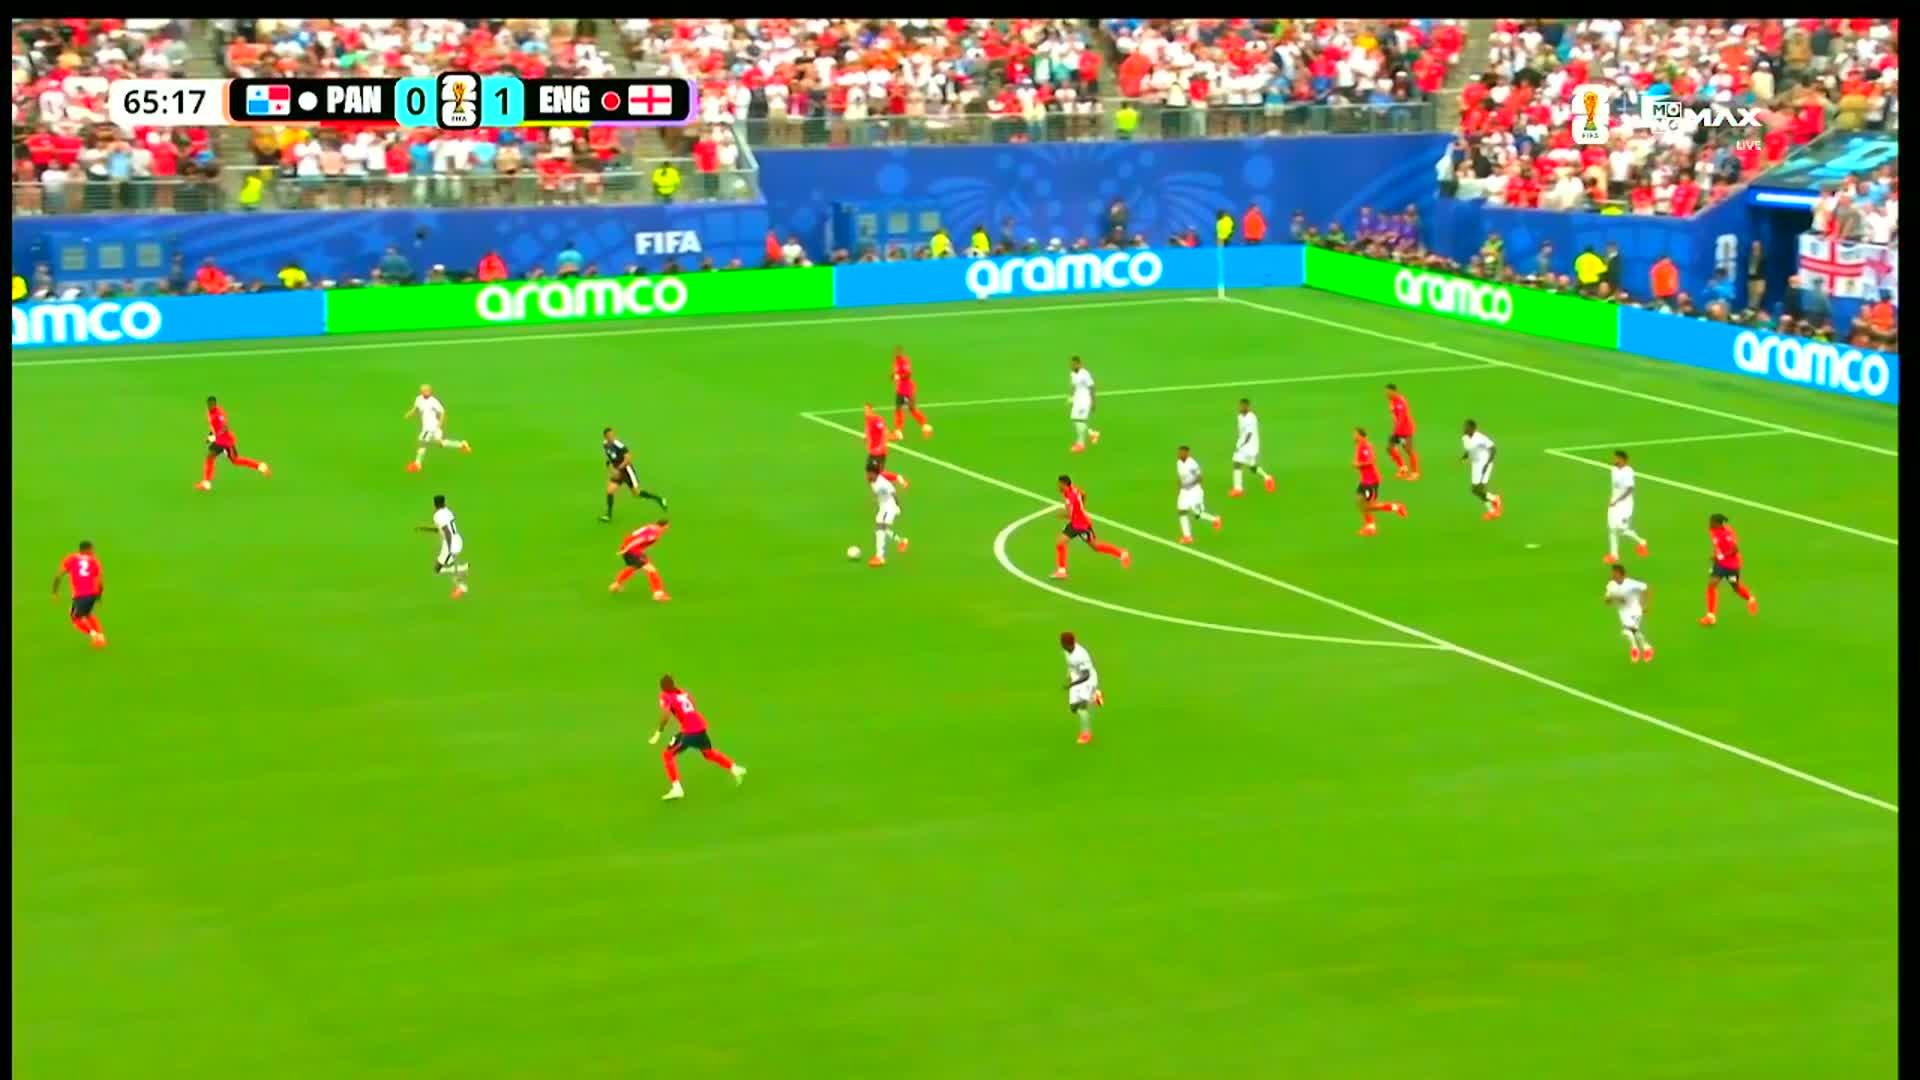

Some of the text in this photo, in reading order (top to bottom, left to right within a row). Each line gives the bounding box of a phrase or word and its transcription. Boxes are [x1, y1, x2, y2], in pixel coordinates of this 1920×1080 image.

[634, 230, 702, 255] FIFA
[965, 250, 1163, 295] aramco
[476, 277, 688, 321] aramco
[1394, 269, 1513, 324] aramco
[1733, 330, 1890, 396] aramco
